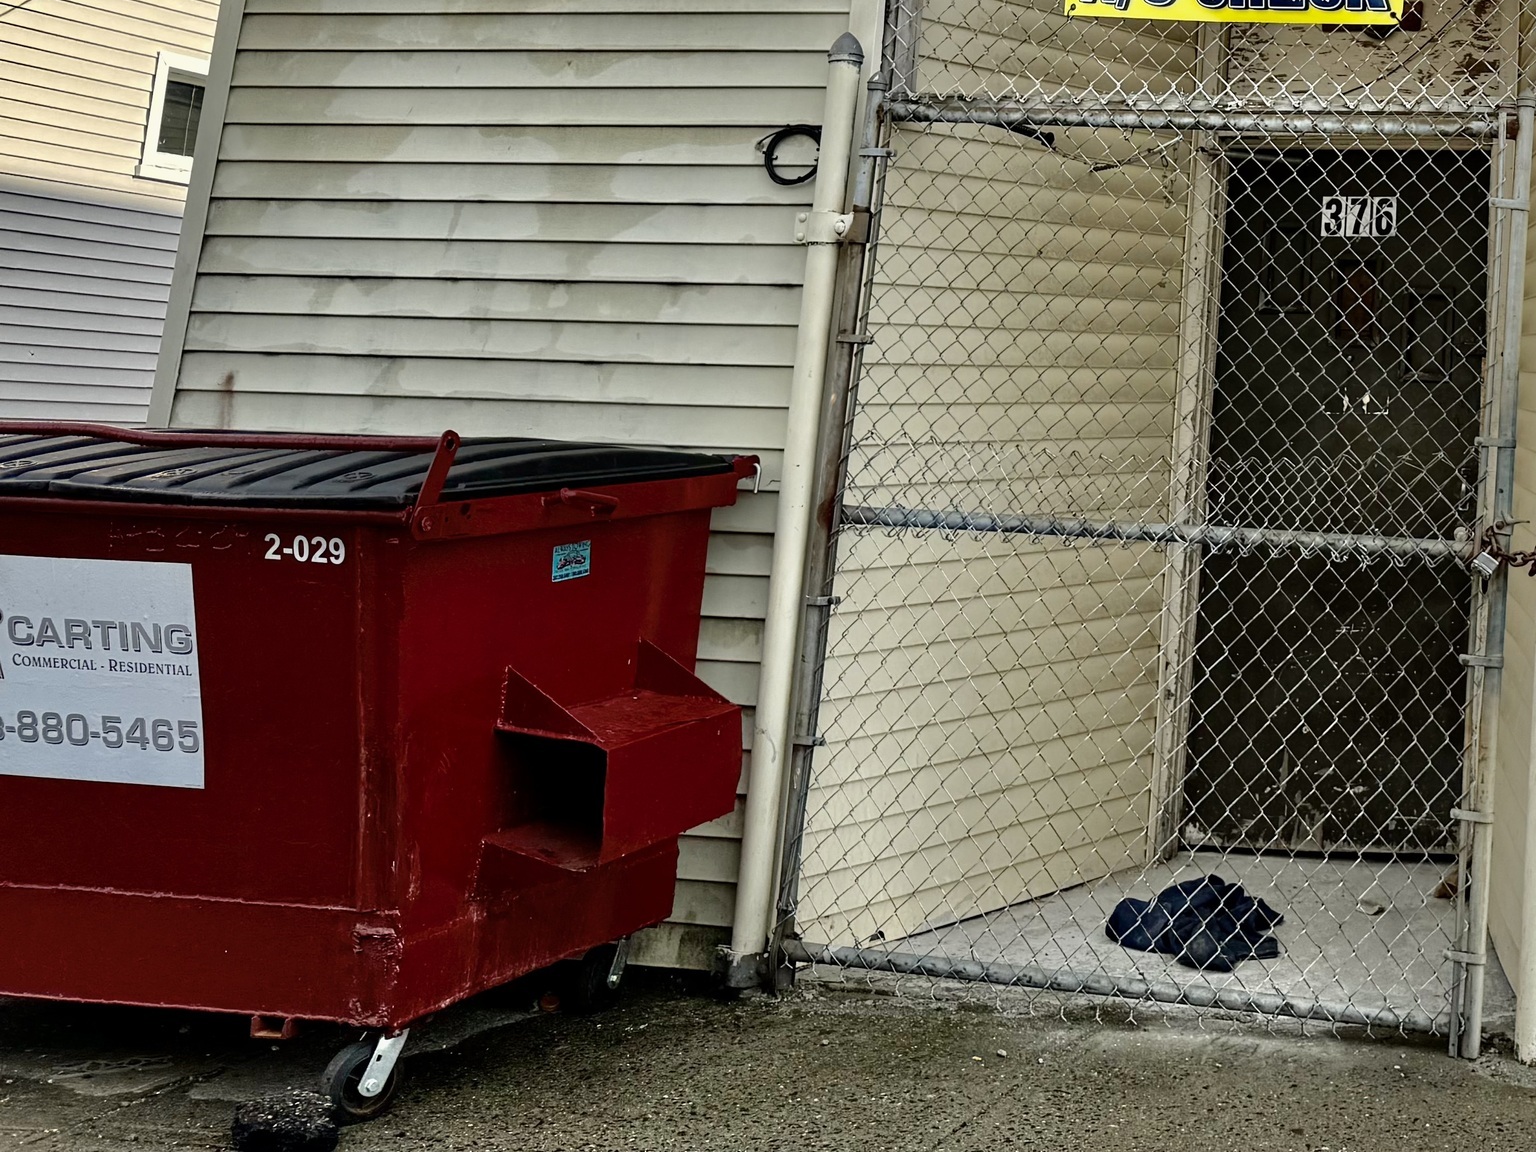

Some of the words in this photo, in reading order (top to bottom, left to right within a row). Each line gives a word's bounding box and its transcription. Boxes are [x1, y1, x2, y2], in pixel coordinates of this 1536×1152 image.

[1324, 197, 1394, 236] 376
[263, 533, 346, 565] 2-029
[7, 615, 193, 655] CARTING
[0, 710, 200, 754] -880-5465
